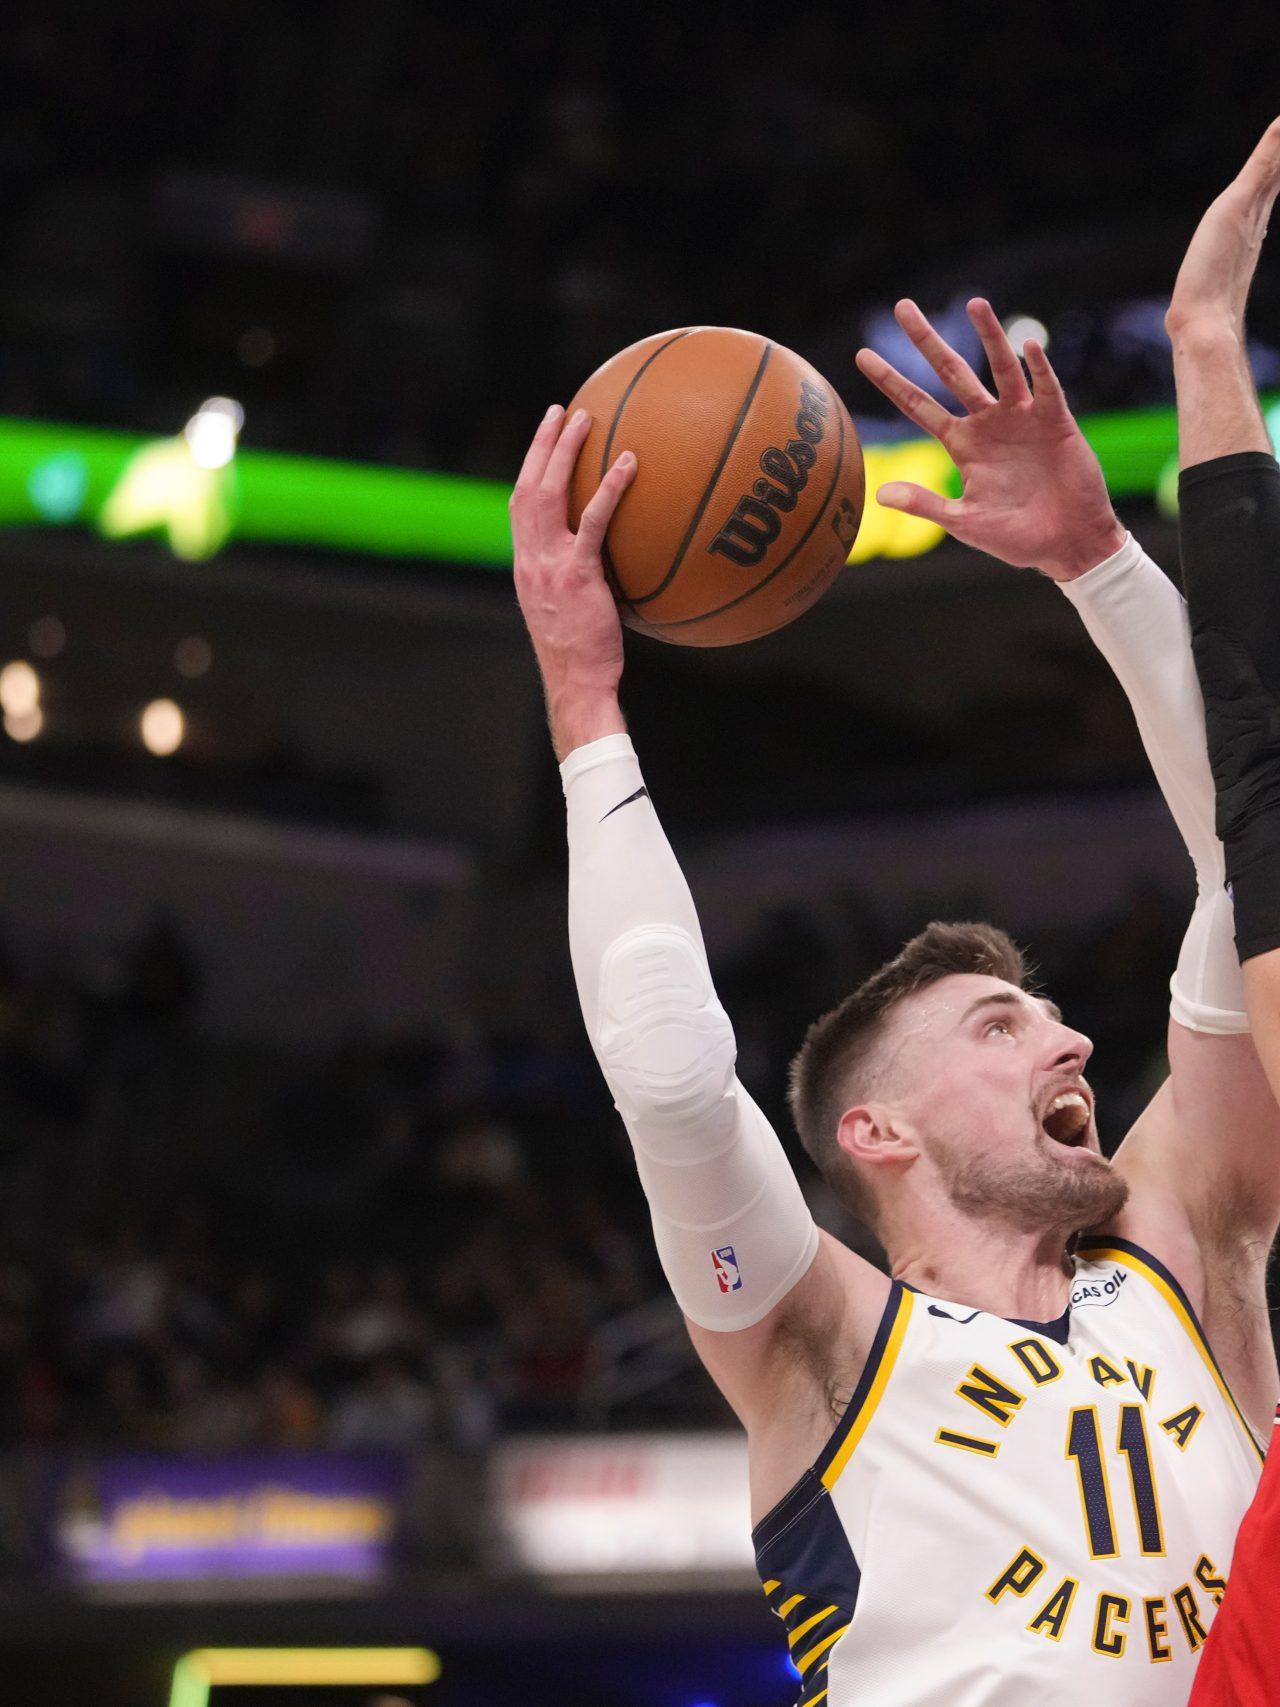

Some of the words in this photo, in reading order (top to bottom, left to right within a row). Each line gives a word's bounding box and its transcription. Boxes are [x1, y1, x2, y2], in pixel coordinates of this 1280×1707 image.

[705, 380, 830, 567] Wilson
[1072, 1286, 1102, 1304] CAS
[1104, 1269, 1127, 1296] OIL
[1064, 1403, 1167, 1561] 11
[984, 1544, 1227, 1664] PACERS
